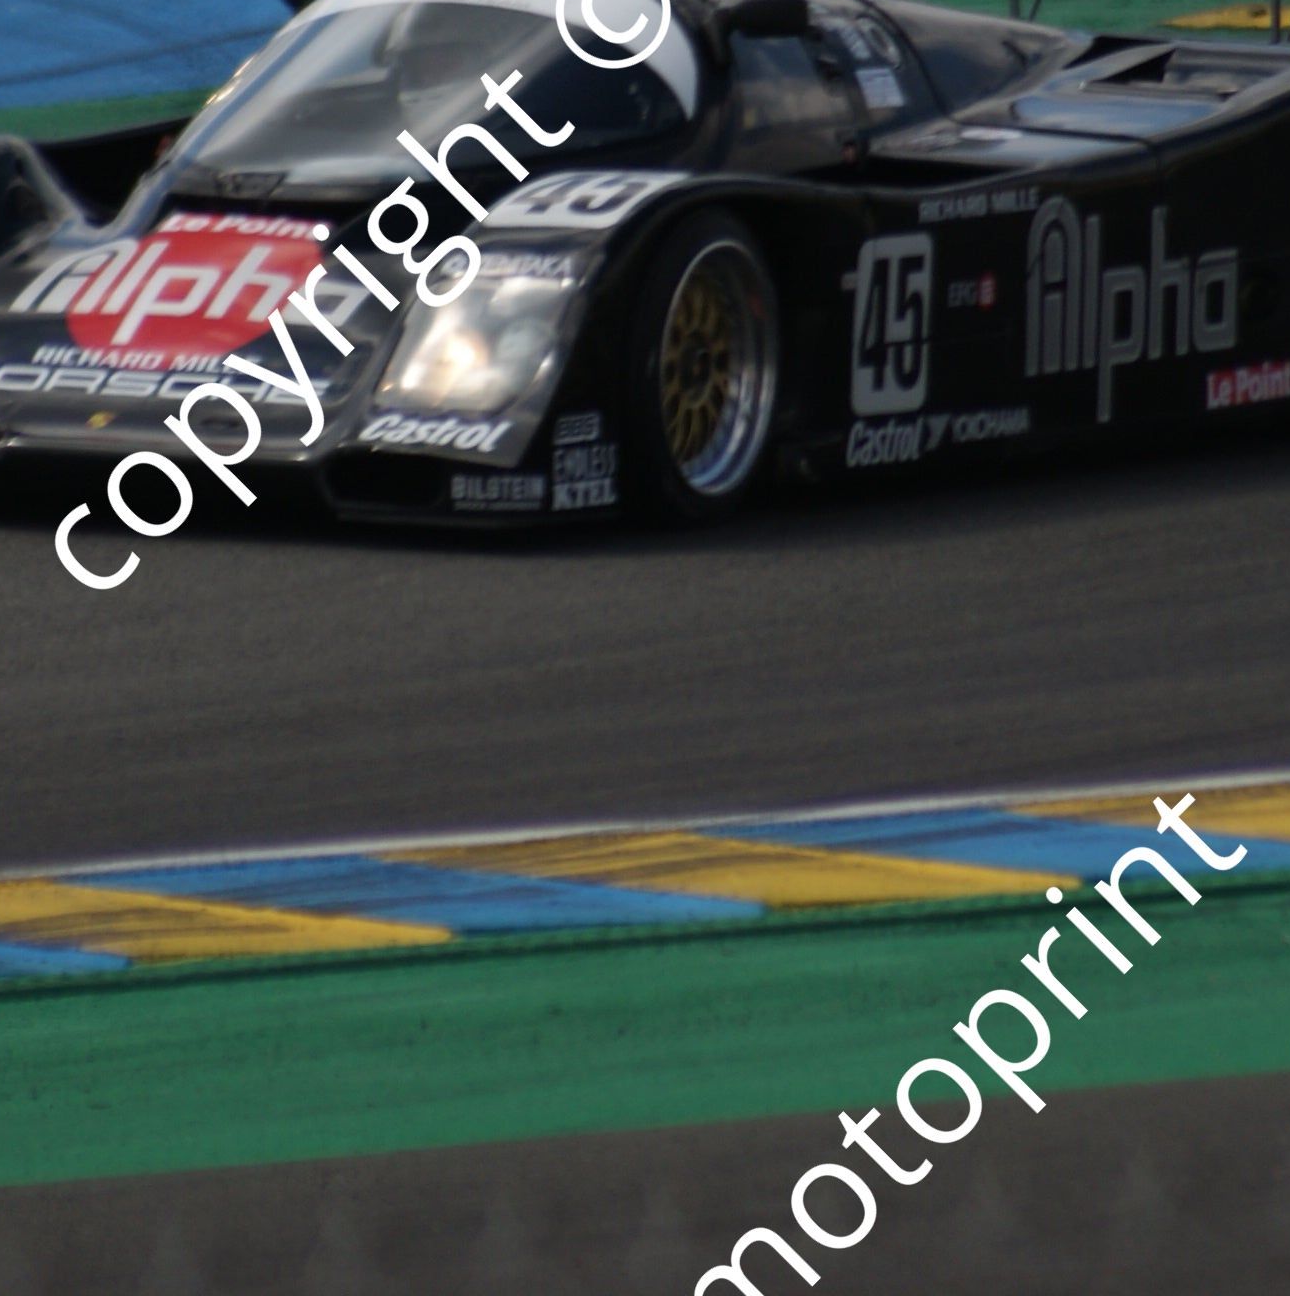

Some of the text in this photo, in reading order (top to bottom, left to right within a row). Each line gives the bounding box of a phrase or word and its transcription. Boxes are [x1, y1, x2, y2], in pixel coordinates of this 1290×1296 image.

[509, 172, 651, 215] 45
[160, 212, 317, 239] Le Poin
[7, 237, 370, 346] Alpha
[1025, 197, 1238, 423] Alpha
[858, 251, 927, 395] 45
[31, 344, 165, 371] RICHARD
[1207, 371, 1234, 408] Le
[357, 408, 514, 453] Castrol
[845, 416, 926, 468] Castrol
[450, 474, 545, 500] BILSTEIN
